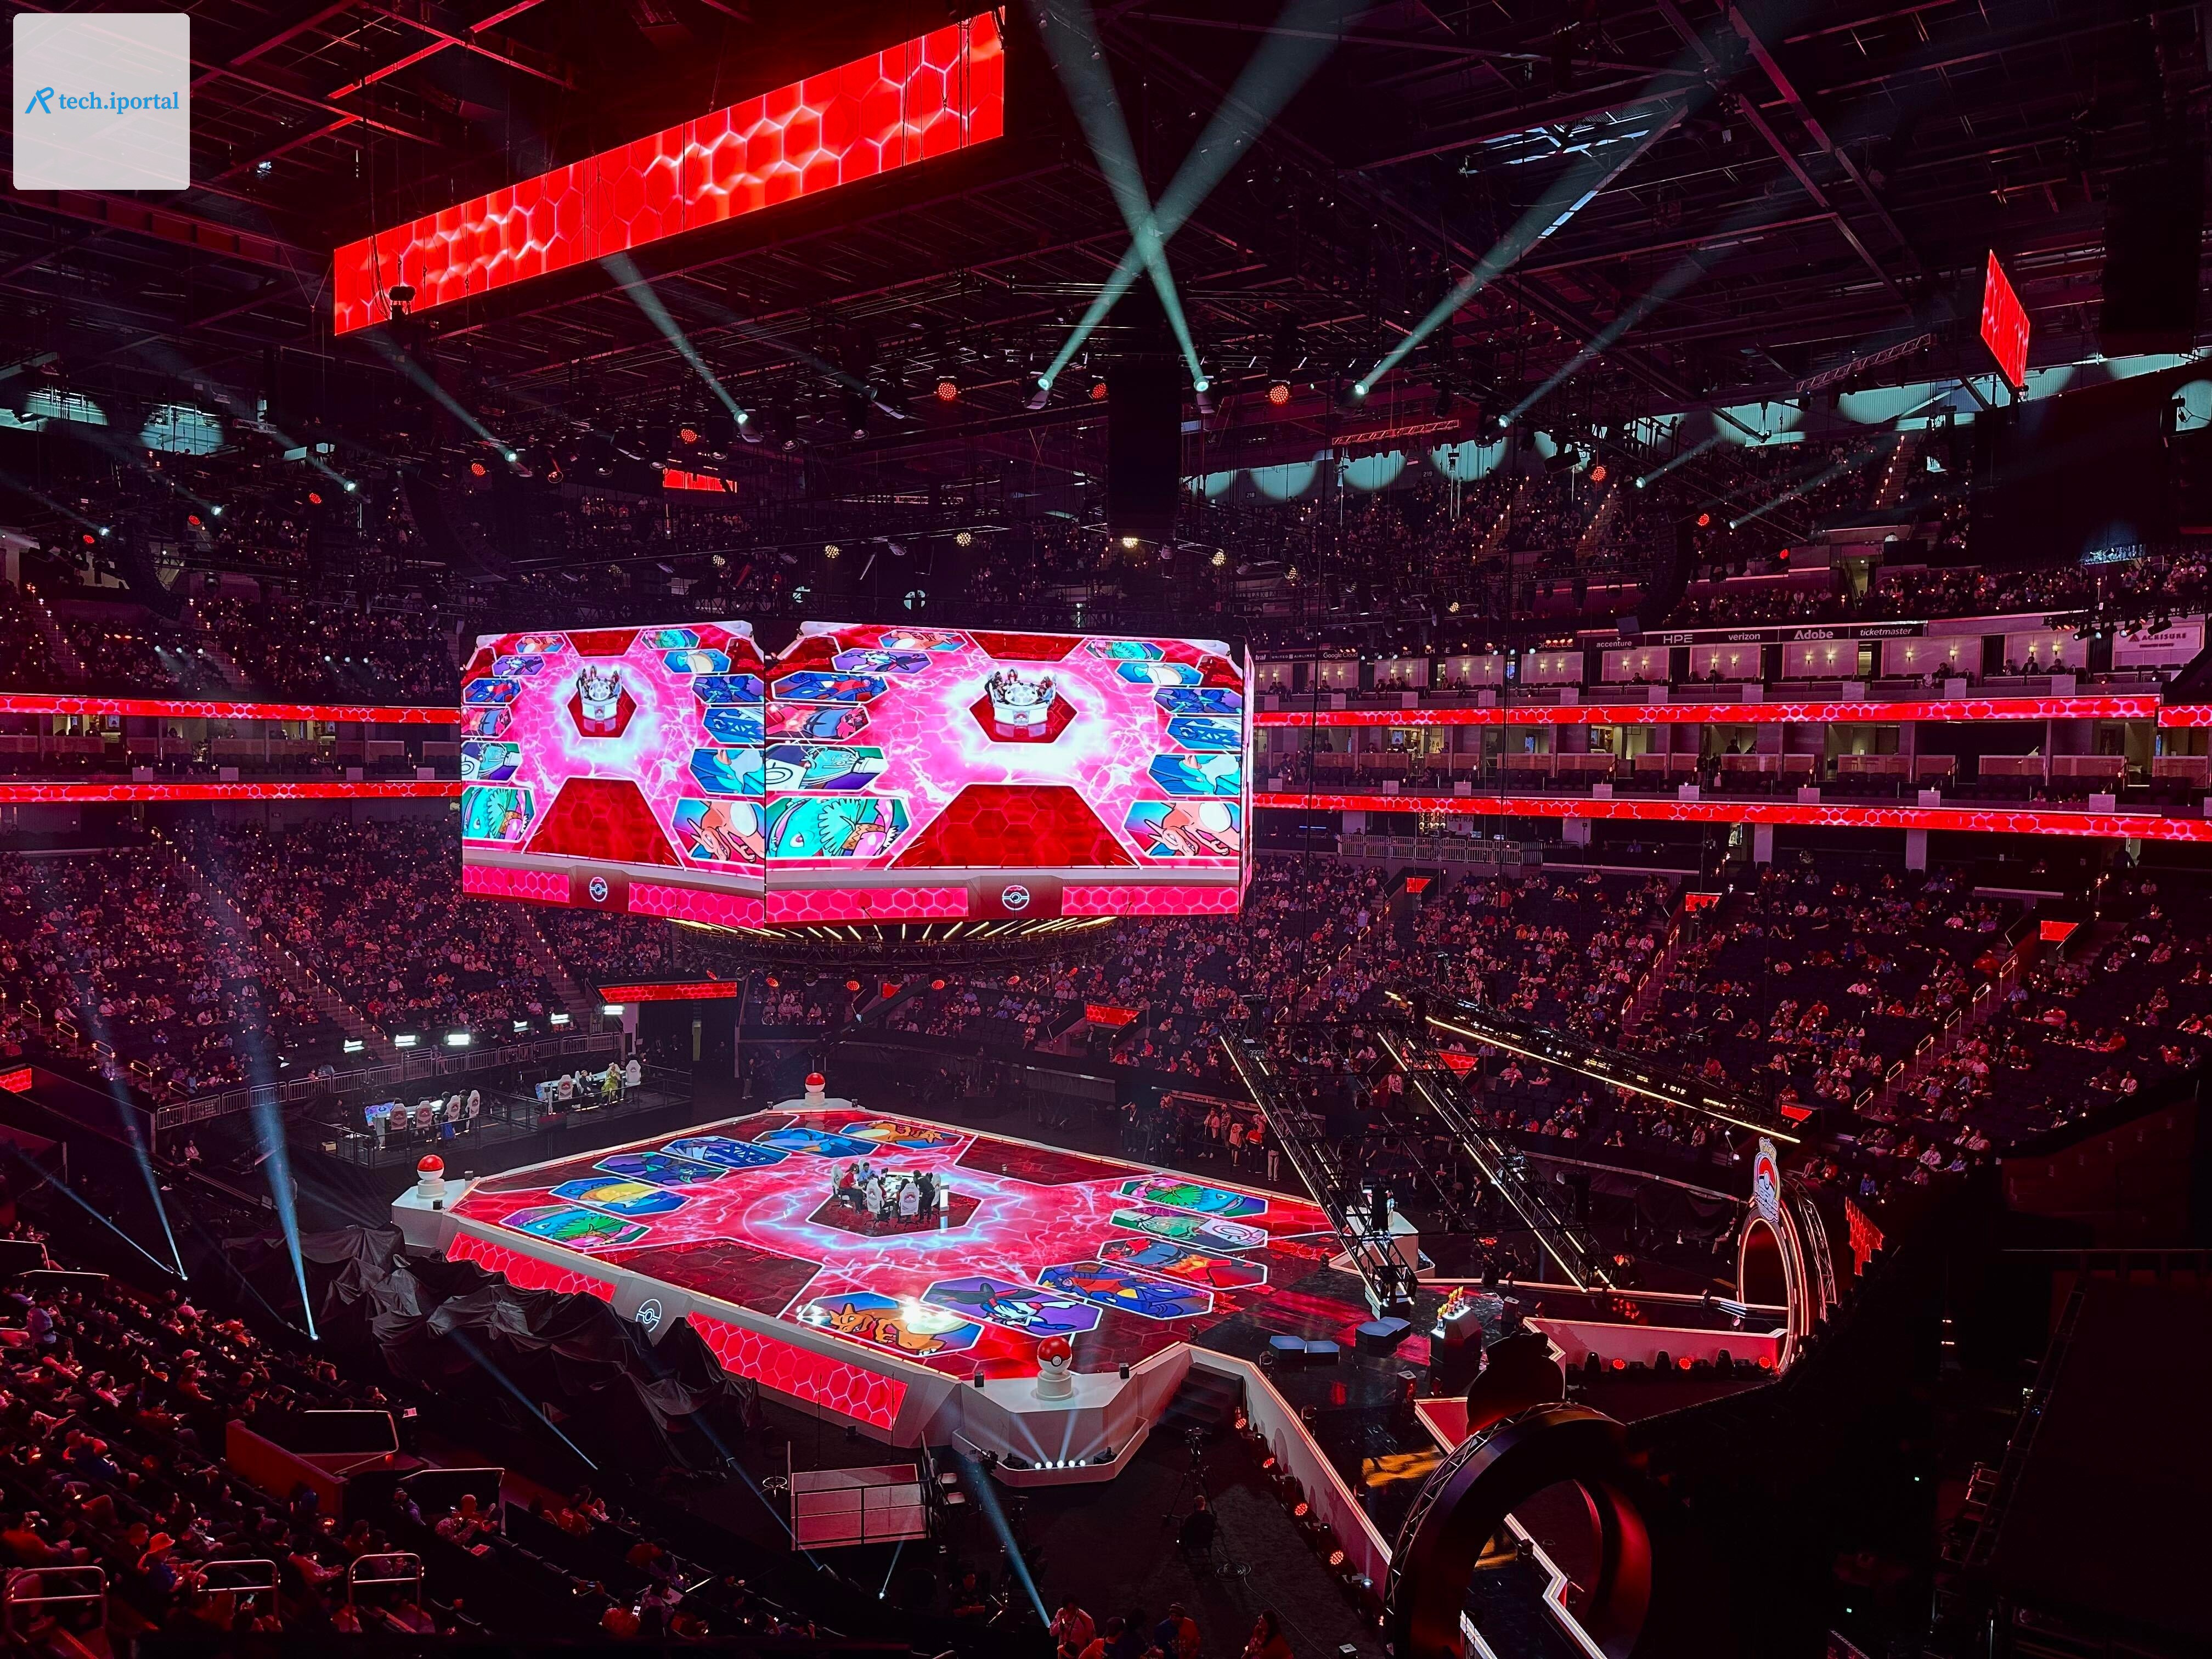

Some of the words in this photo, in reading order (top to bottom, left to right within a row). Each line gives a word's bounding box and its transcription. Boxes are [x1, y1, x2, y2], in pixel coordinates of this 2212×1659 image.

[1663, 634, 1693, 644] HPE
[1728, 633, 1760, 641] verizon
[1793, 629, 1833, 640] Adobe
